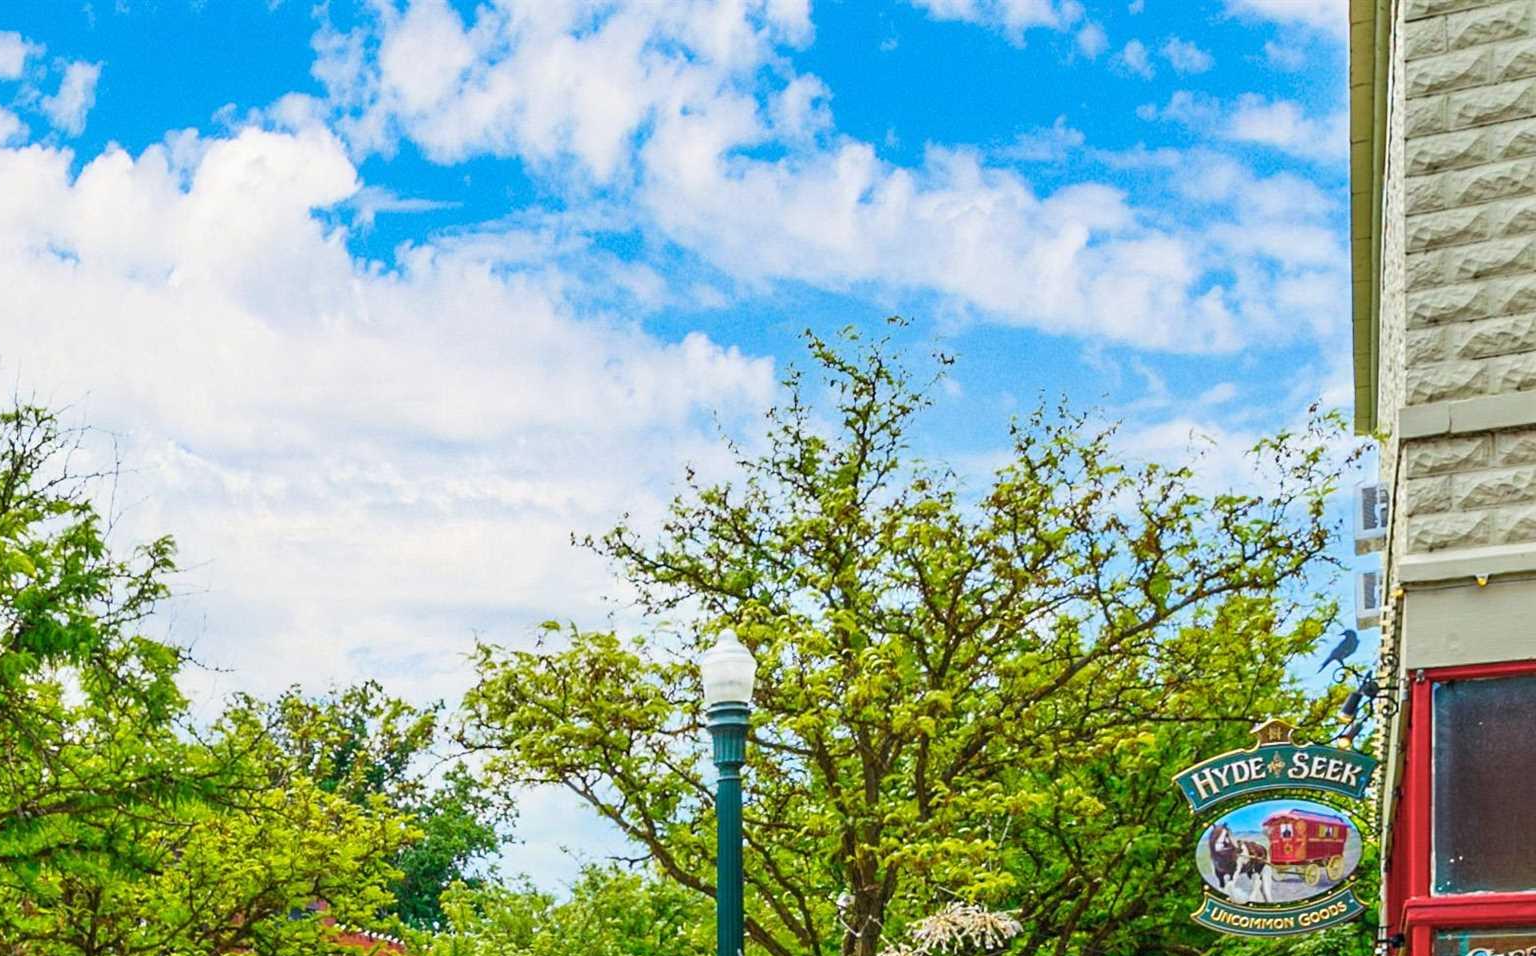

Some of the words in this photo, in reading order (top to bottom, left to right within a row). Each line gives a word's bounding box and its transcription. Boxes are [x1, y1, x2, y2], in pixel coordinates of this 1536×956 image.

[1191, 757, 1266, 800] HYDE
[1287, 752, 1363, 787] SEEK
[1211, 907, 1294, 929] UNCOMMON
[1298, 901, 1348, 927] GOODS
